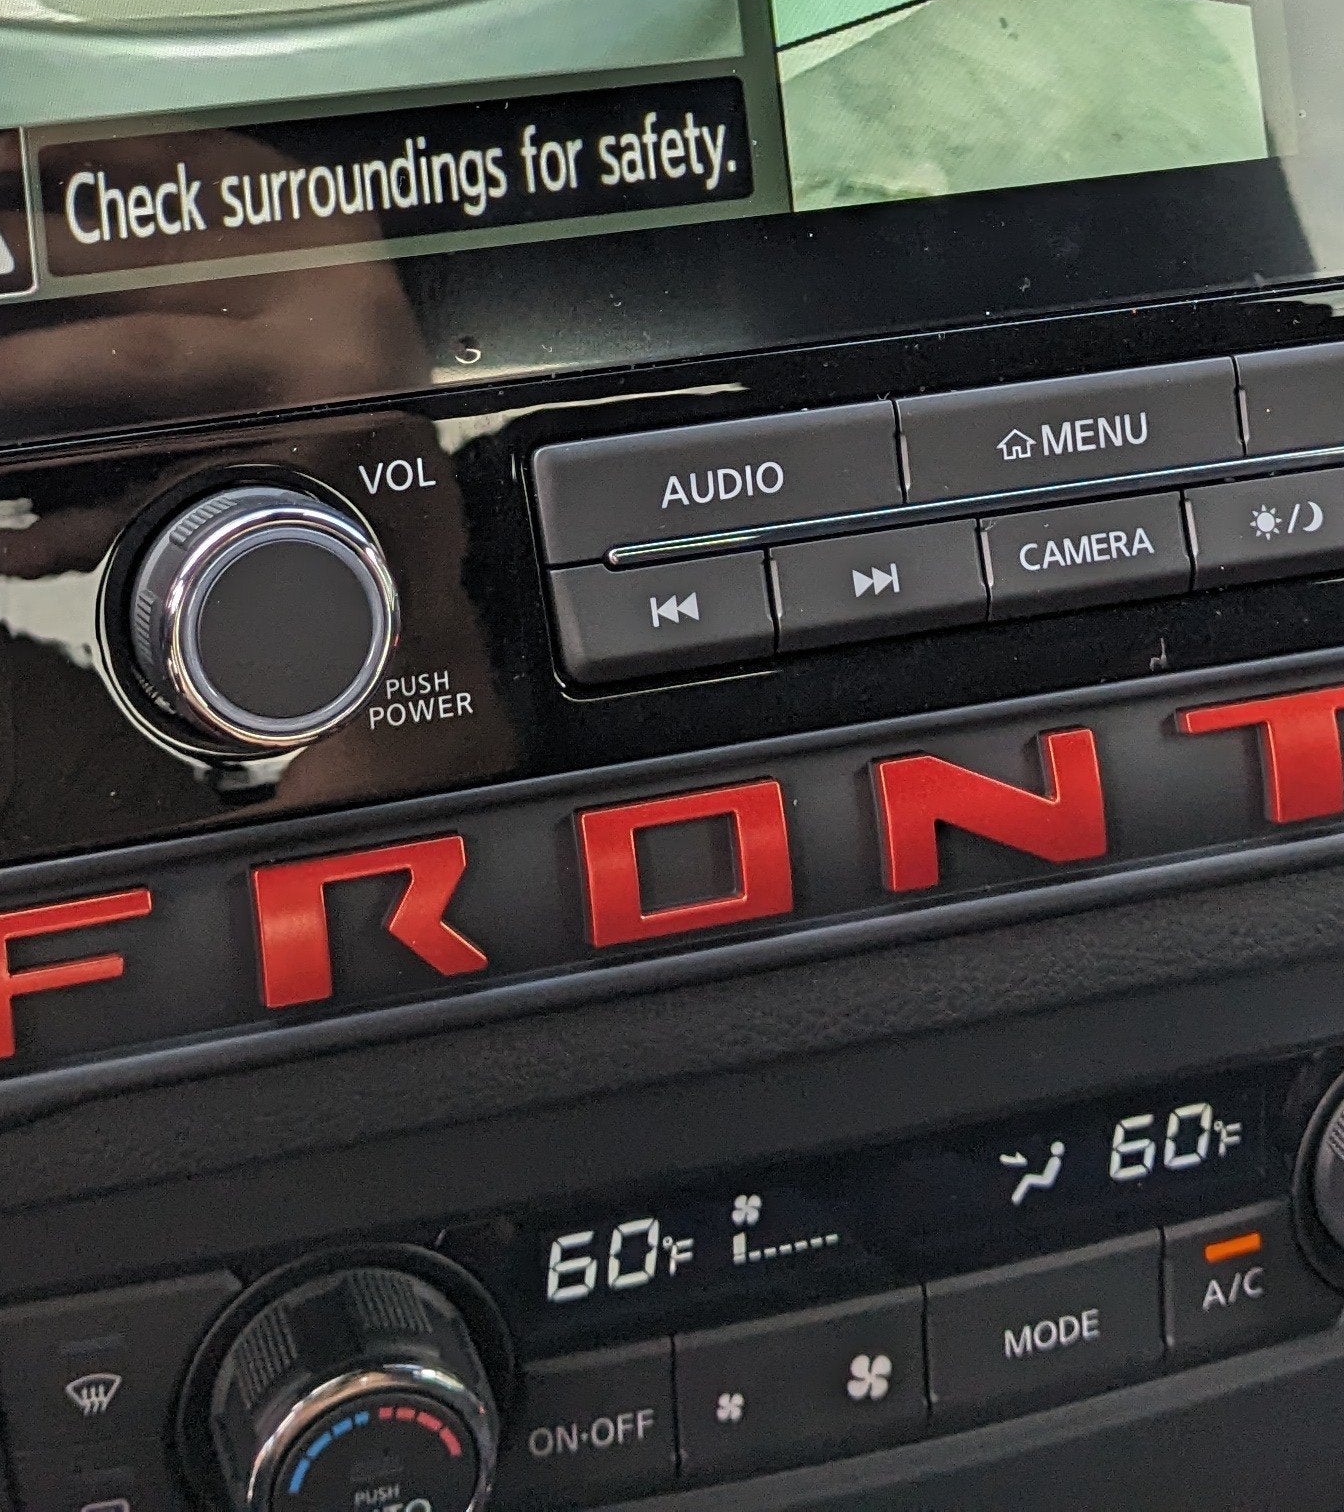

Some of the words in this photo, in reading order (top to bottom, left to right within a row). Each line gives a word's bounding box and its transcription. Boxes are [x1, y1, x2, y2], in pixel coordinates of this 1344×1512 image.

[63, 163, 206, 244] Check
[220, 137, 508, 228] surroundings
[520, 125, 583, 192] for
[598, 111, 737, 190] safety.
[1040, 412, 1149, 456] MENU
[358, 457, 436, 495] VOL
[659, 461, 787, 510] AUDIO
[1017, 528, 1155, 574] CAMERA
[386, 670, 449, 699] PUSH
[369, 692, 474, 730] POWER
[1202, 1267, 1265, 1309] A/C
[1003, 1308, 1100, 1358] MODE
